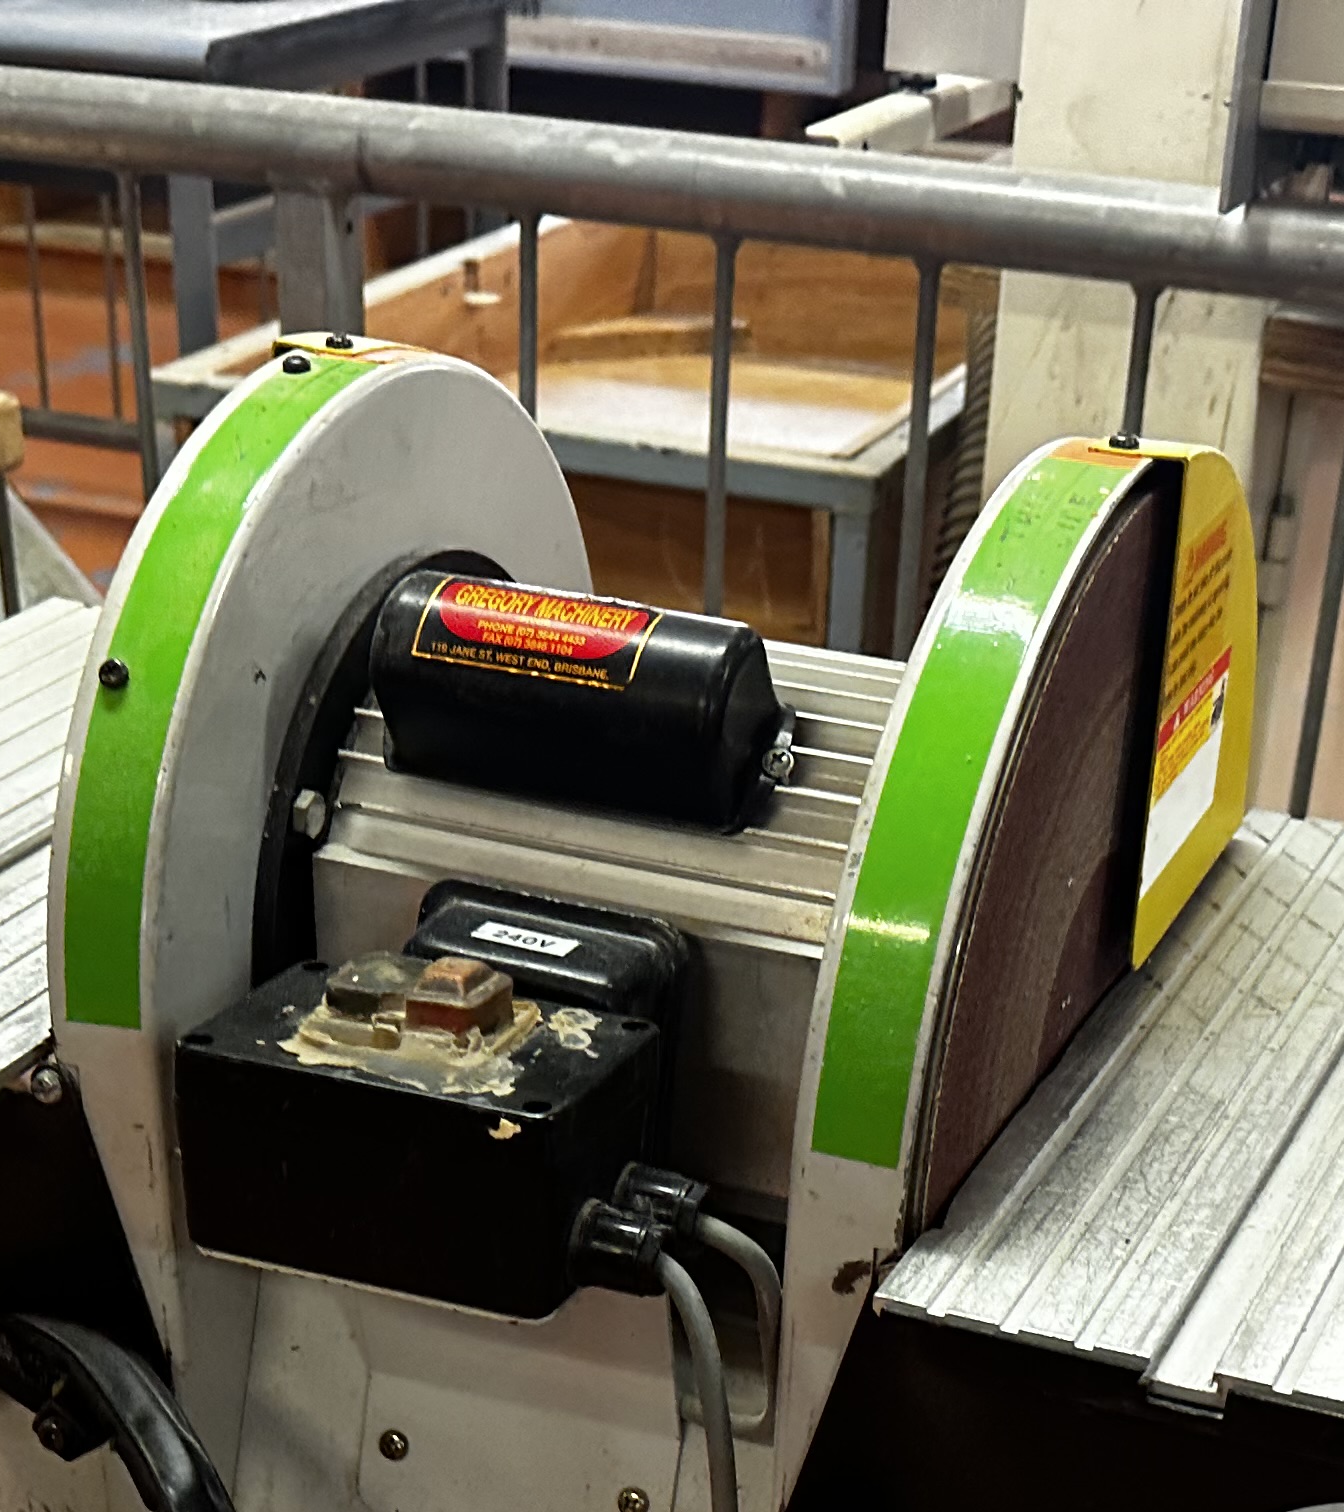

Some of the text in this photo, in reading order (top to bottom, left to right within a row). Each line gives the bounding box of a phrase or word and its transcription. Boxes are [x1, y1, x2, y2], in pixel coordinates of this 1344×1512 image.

[456, 585, 639, 630] GREGORY MACHINERY
[477, 620, 515, 634] PHONE
[482, 632, 502, 645] FAX
[449, 644, 476, 658] JANE
[496, 651, 525, 666] WEST
[527, 656, 551, 672] END,
[554, 661, 609, 680] BRISBANE.
[492, 929, 556, 948] 240V
